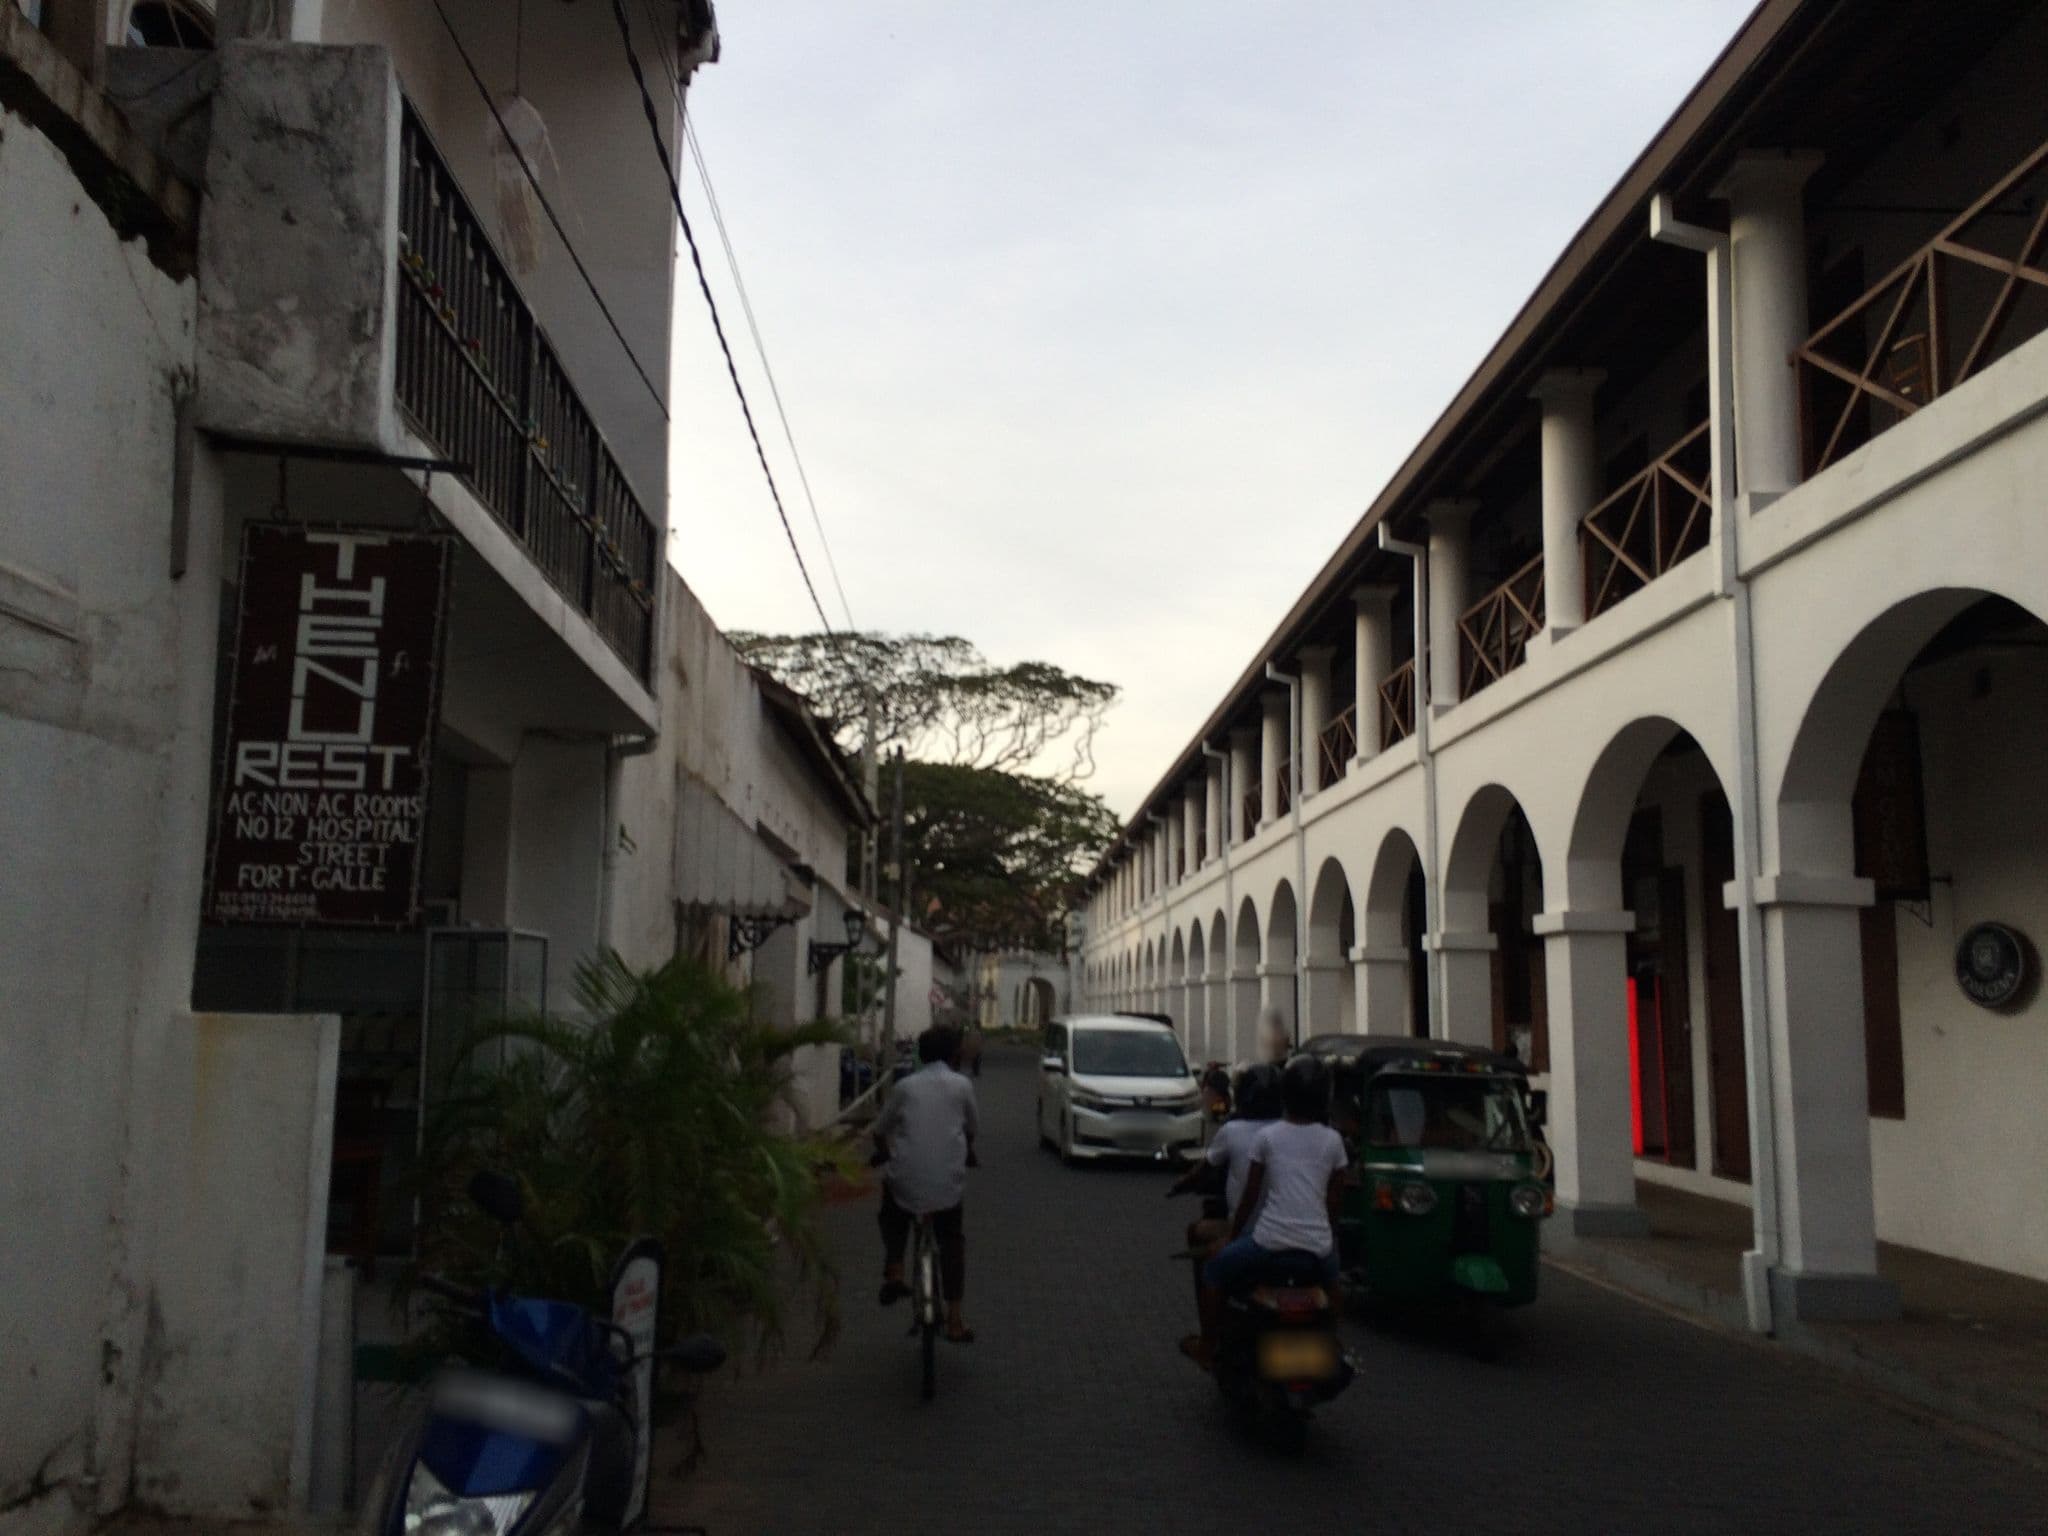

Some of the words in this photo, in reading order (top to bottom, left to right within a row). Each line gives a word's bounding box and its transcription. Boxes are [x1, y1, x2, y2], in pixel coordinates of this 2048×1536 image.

[287, 531, 389, 744] THENU
[233, 740, 411, 791] REST
[353, 792, 421, 819] ROOMS
[235, 815, 268, 840] NO
[273, 816, 294, 841] 12
[307, 816, 415, 843] HOSPITAL
[296, 841, 390, 867] STREET
